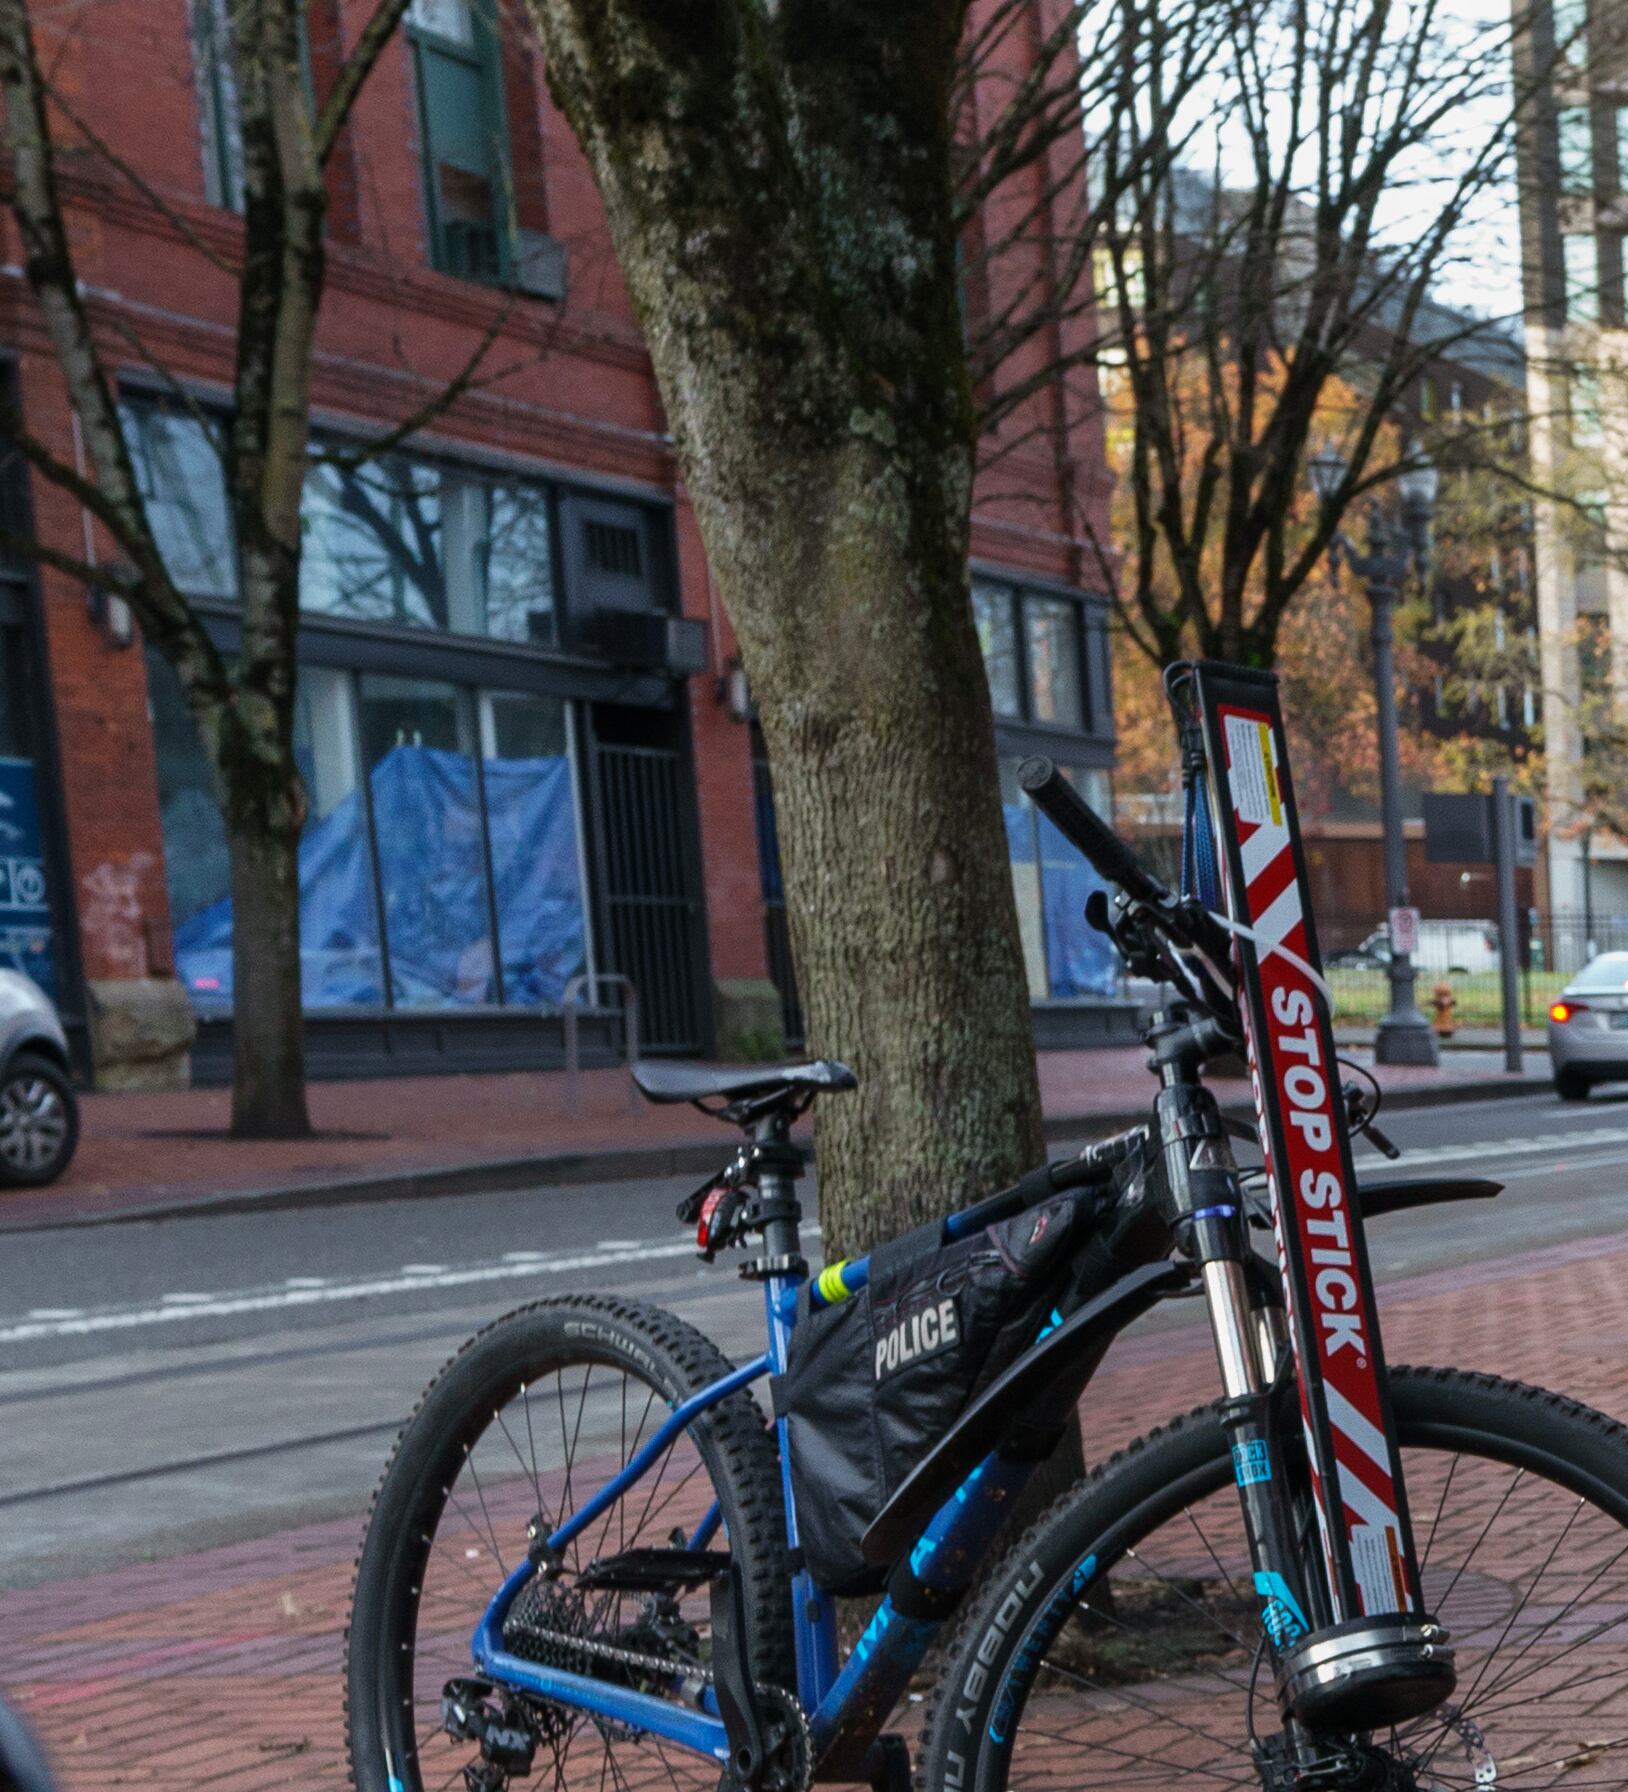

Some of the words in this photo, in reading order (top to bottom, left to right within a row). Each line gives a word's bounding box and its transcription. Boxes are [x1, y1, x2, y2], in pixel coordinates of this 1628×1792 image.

[1271, 985, 1333, 1153] STOP
[875, 1298, 957, 1381] POLICE
[1300, 1167, 1366, 1358] STICK
